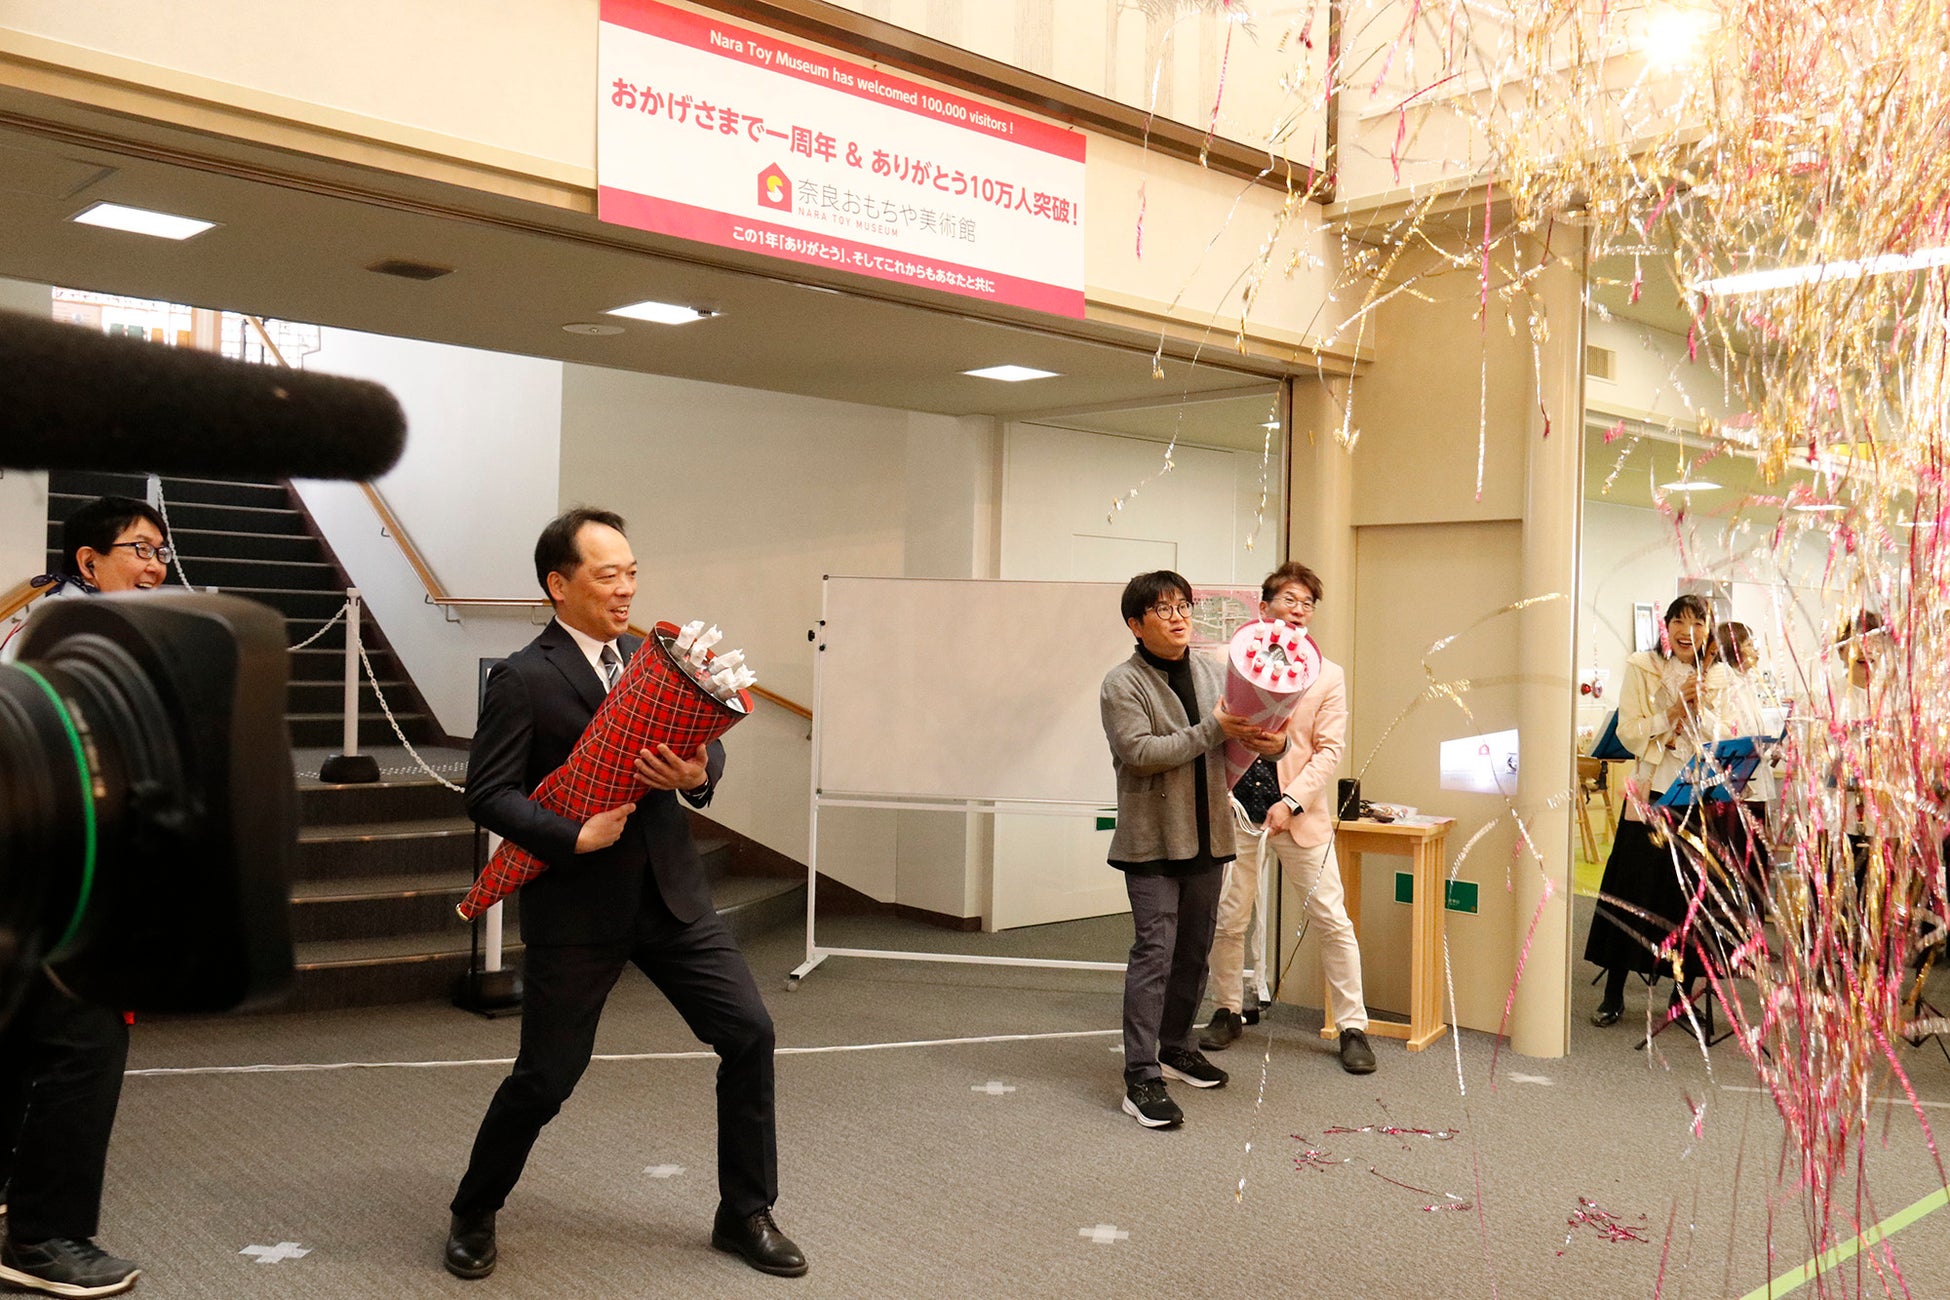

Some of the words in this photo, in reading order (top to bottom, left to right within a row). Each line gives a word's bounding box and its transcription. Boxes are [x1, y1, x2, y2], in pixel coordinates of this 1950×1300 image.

[709, 30, 743, 53] Nara
[747, 41, 772, 65] Toy
[775, 52, 829, 79] Museum
[832, 67, 854, 86] has
[857, 77, 918, 106] welcomed
[921, 95, 967, 120] 100,000
[969, 111, 1007, 133] visitors
[611, 77, 837, 163] おかげさまで一周年
[846, 141, 863, 169] &
[732, 226, 996, 293] この1年「ありがとう」、そしてこれからもあなたと共に
[798, 207, 828, 222] NARA
[832, 214, 852, 228] TOY
[856, 220, 899, 238] MUSEUM
